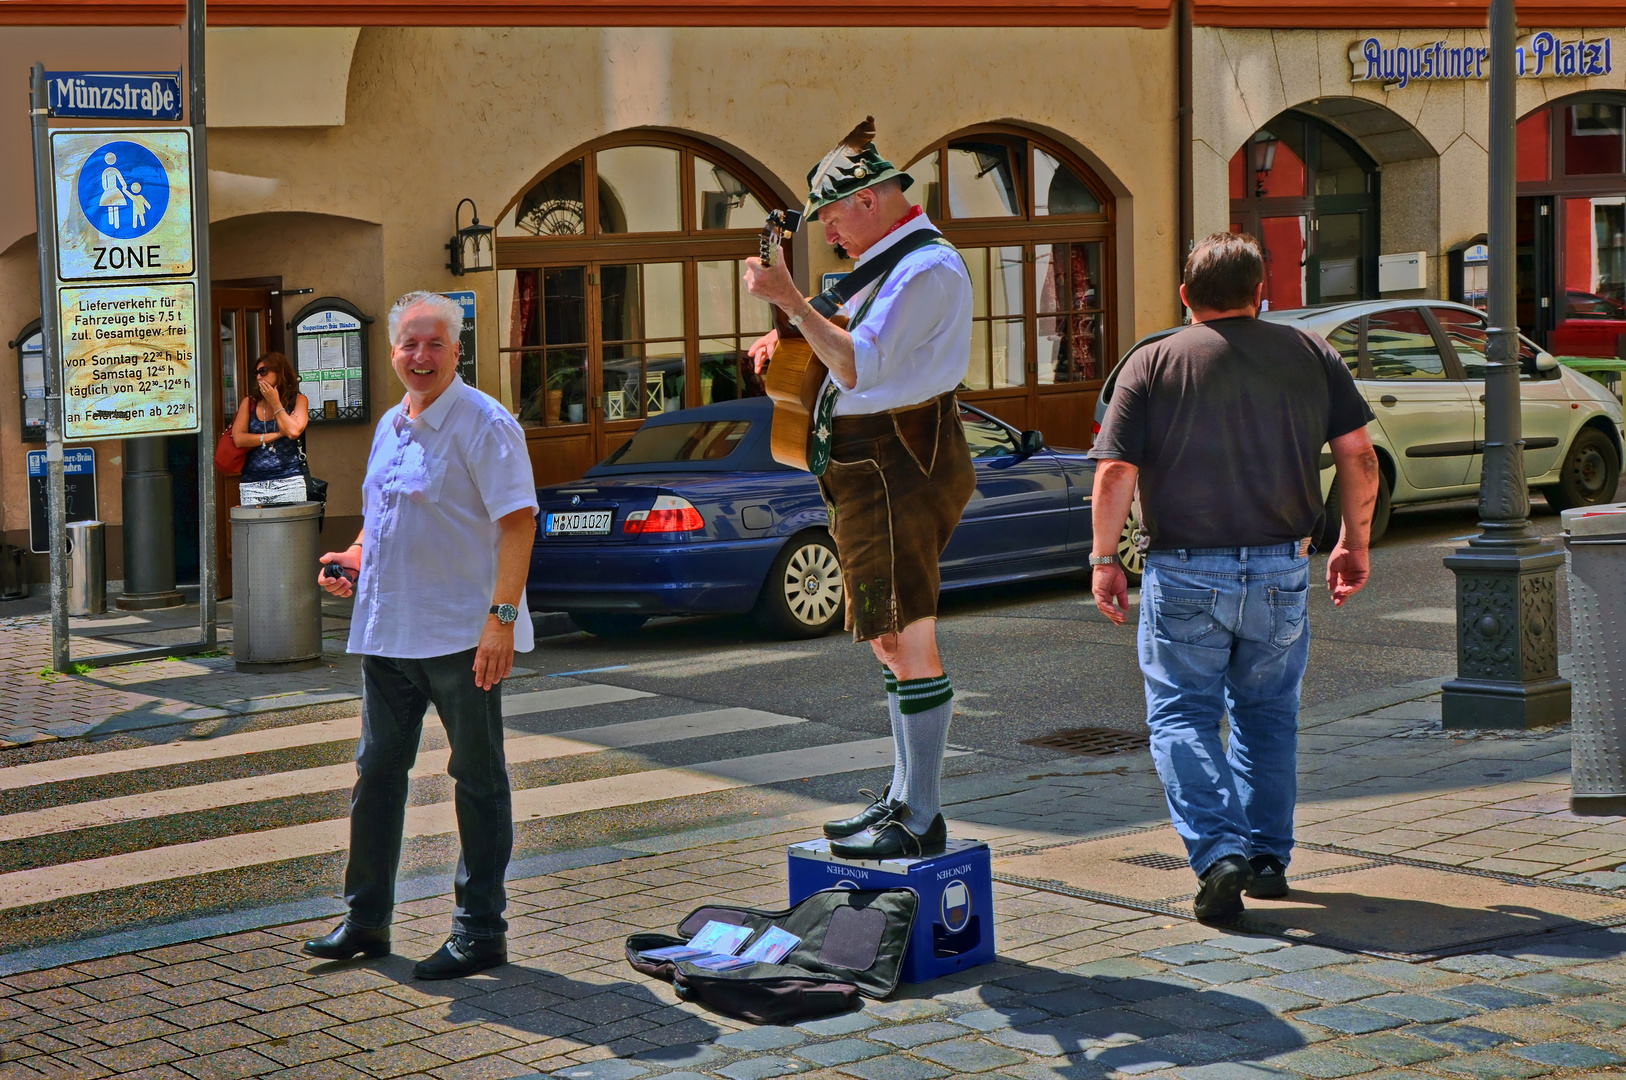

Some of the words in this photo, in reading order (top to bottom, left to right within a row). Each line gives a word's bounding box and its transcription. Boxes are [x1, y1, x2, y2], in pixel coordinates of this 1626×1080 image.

[1364, 38, 1486, 89] Augustiner
[1533, 31, 1612, 76] Platzl
[57, 78, 174, 116] Münzstraße
[93, 245, 161, 270] ZONE
[79, 299, 157, 311] Lieferverkehr
[161, 297, 176, 308] für
[75, 315, 135, 326] Fahrzeuge
[139, 312, 155, 323] bis
[178, 311, 181, 320] t
[71, 331, 91, 340] zul.
[96, 328, 164, 340] Gesamtgew.
[168, 325, 186, 335] frei
[66, 357, 85, 367] von
[92, 354, 138, 366] Sonntag
[165, 352, 172, 361] h
[177, 351, 192, 361] bis
[93, 368, 142, 380] Samstag
[168, 366, 174, 375] h
[70, 384, 108, 398] täglich
[113, 384, 133, 393] von
[184, 379, 190, 388] h
[67, 413, 80, 422] an
[150, 406, 161, 416] ab
[188, 404, 193, 414] h
[553, 515, 559, 530] M
[566, 515, 580, 529] XD
[582, 514, 609, 529] 1027
[826, 865, 869, 879] MÜNCHEN
[936, 863, 972, 881] MÜNCHEN
